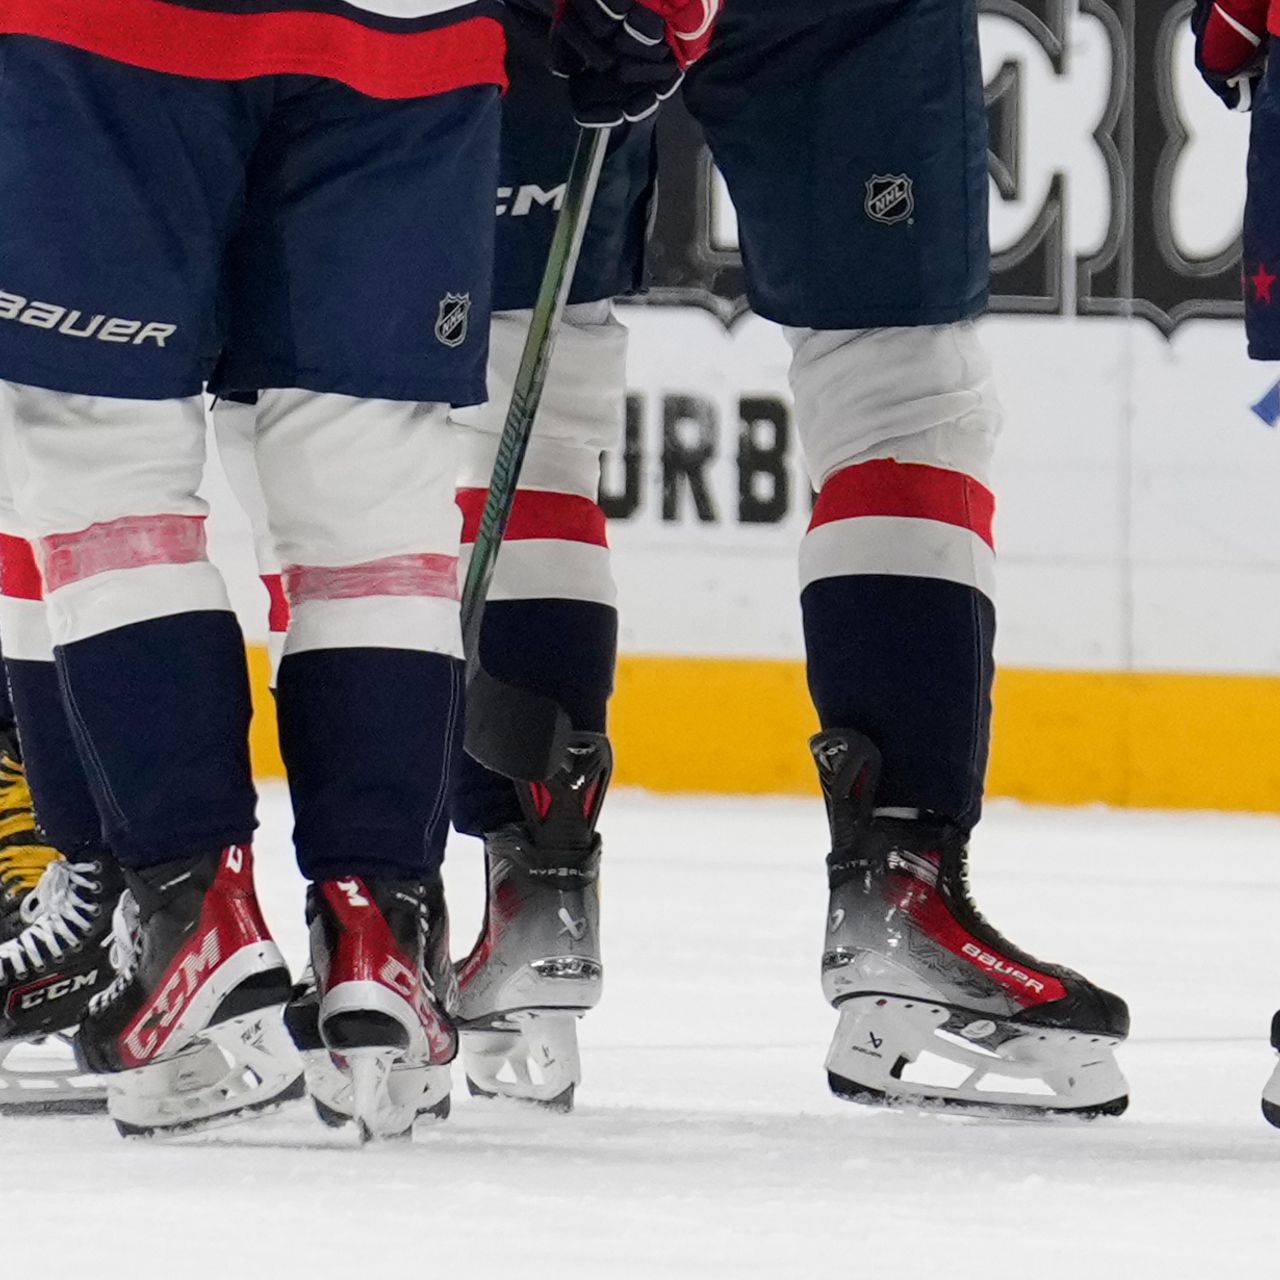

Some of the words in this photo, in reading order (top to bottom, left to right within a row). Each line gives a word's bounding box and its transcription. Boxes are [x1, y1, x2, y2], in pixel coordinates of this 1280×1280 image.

[21, 969, 100, 1009] CCM
[124, 926, 222, 1061] CCM
[961, 942, 1045, 995] BAUER
